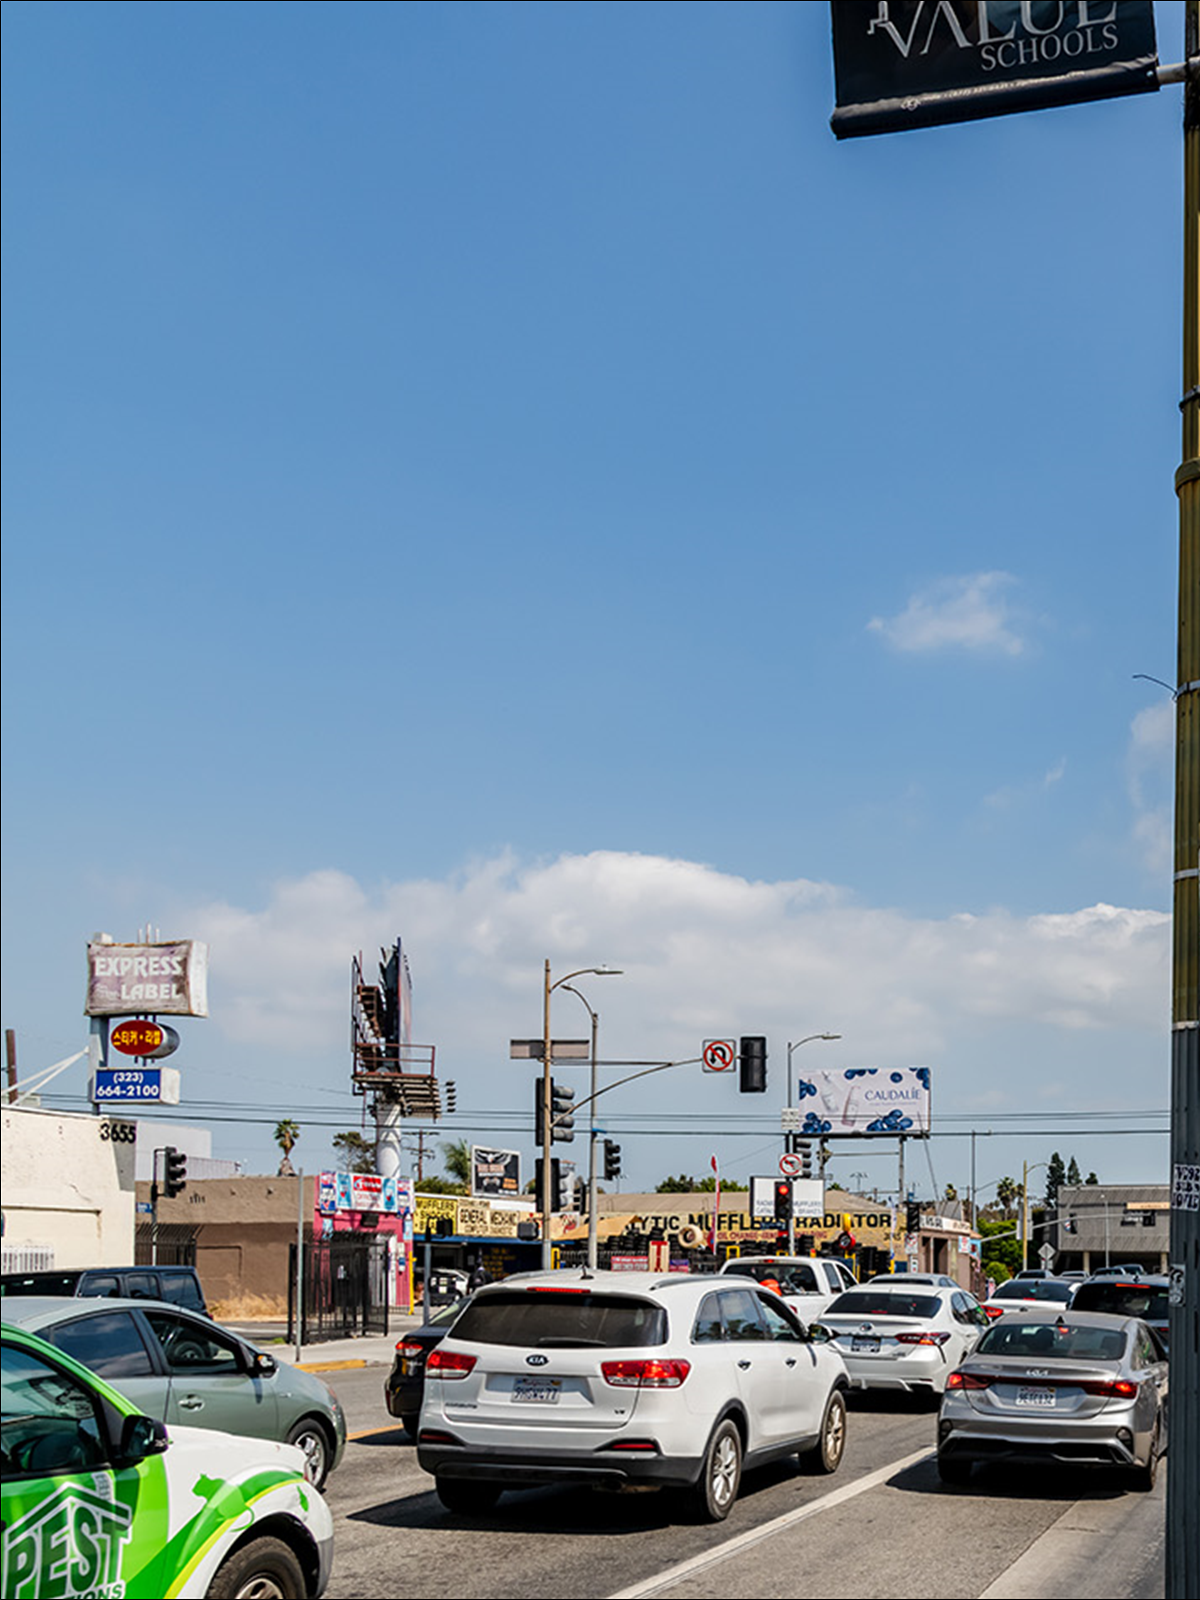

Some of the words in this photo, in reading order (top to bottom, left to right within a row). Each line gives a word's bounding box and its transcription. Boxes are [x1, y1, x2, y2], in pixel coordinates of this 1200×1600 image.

[981, 24, 1118, 71] SCHOOLS
[94, 956, 183, 978] EXPRESS
[120, 983, 182, 1000] LABEL
[113, 1072, 144, 1084] (323)
[97, 1085, 159, 1097] 664-2100
[100, 1123, 137, 1143] 3655
[529, 1356, 546, 1364] KIA
[4, 1503, 131, 1600] PEST
